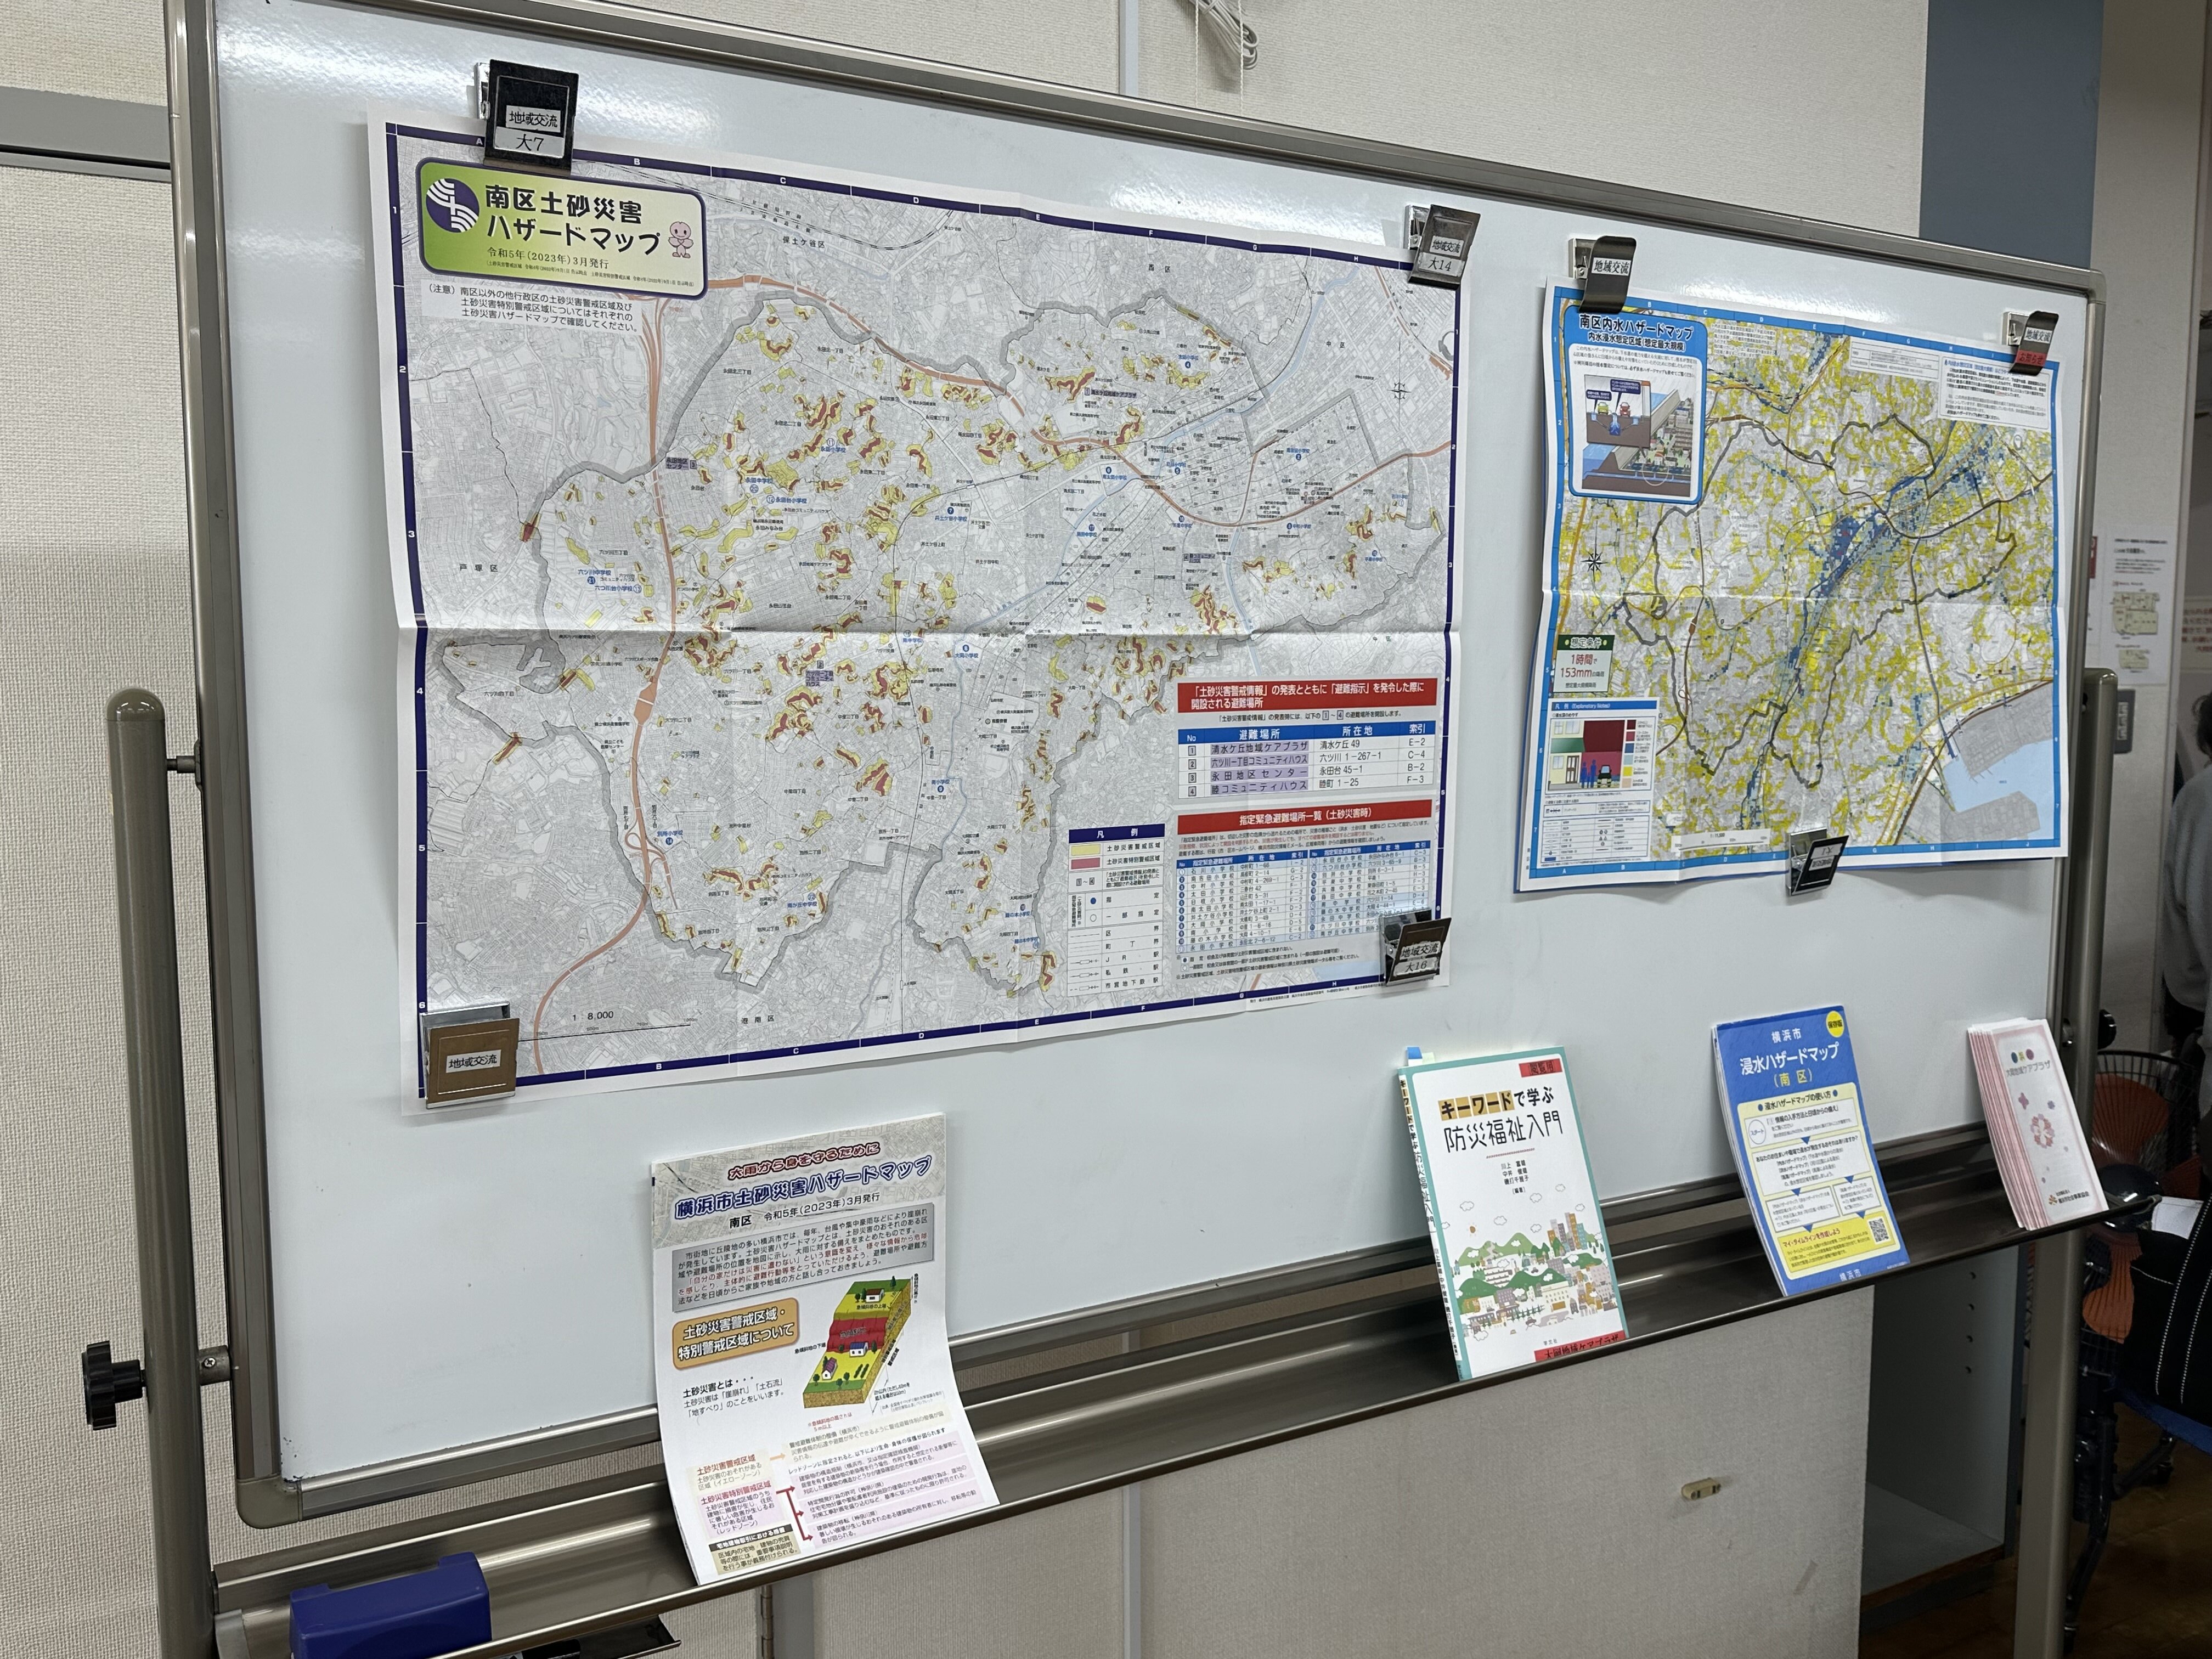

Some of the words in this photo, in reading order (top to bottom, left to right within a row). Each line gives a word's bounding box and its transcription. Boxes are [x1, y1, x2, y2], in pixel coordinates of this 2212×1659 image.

[509, 110, 558, 128] 地域交流
[516, 134, 545, 151] 大7
[486, 185, 642, 224] 南区土砂災害
[487, 215, 661, 255] ハザードマップ
[1432, 240, 1460, 253] 地域交流
[1428, 257, 1451, 271] 大14
[1594, 259, 1630, 274] 地域交流
[429, 284, 455, 295] （注意）
[1579, 313, 1694, 340] 南区内水ハザードマップ
[2027, 329, 2051, 341] 地域交流
[2019, 353, 2044, 364] お知らせ
[460, 564, 498, 572] 戸塚区
[1571, 637, 1602, 649] 想定条件
[1191, 697, 1263, 710] 開設される避難場所
[1239, 729, 1280, 740] 避難場所
[1342, 726, 1373, 736] 所在地
[1409, 724, 1425, 733] 索引
[1211, 741, 1308, 755] 清水ケ丘地域ケアプラザ
[1320, 740, 1348, 750] 清水ケ丘
[1319, 753, 1341, 763] 六ツ川
[1408, 751, 1425, 759] C-4
[1211, 768, 1308, 781] 永田地区センター
[1319, 766, 1341, 776] 永田台
[1408, 763, 1425, 771] B-2
[1211, 781, 1307, 794] 睦コミュニティハウス
[1319, 779, 1334, 788] 睦町
[1097, 828, 1138, 839] 凡例
[1107, 842, 1160, 851] 土砂災害警戒区域
[1401, 943, 1440, 957] 地域交流
[1405, 961, 1427, 972] 大16
[588, 1011, 614, 1021] 8,000
[1771, 1028, 1802, 1043] 横浜市
[448, 1054, 496, 1069] 地域交流
[1740, 1041, 1839, 1075] 浸水ハザードマップ
[1442, 1087, 1554, 1119] キーワードで学ぶ
[1444, 1110, 1563, 1153] 防災福祉入門
[728, 1142, 880, 1180] 大雨から身を守るために
[675, 1155, 932, 1219] 横浜市土砂災害ハザードマップ
[730, 1215, 752, 1229] 南区
[1839, 1269, 1861, 1282] 横浜市
[678, 1323, 794, 1361] 特別警戒区域について
[697, 1454, 755, 1476] 土砂災害警戒区域
[698, 1463, 762, 1483] 土砂災害のおそれがある
[701, 1481, 771, 1505] 土砂災害特別警戒区域
